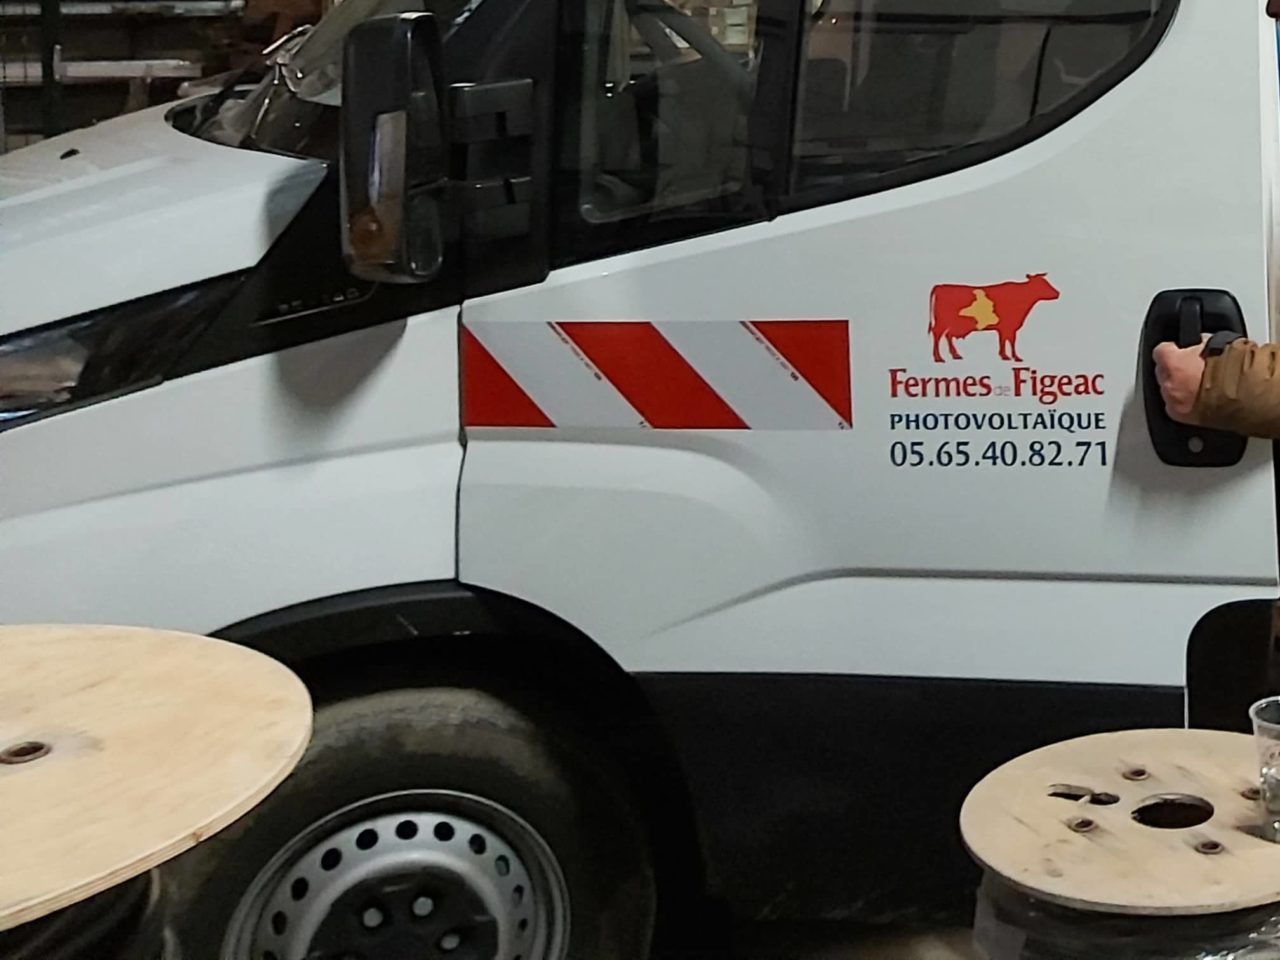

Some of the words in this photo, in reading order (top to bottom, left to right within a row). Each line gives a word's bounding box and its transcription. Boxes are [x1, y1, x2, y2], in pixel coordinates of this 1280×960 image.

[888, 368, 992, 398] Fermes
[993, 385, 1011, 397] de
[1012, 367, 1105, 405] Figeac
[889, 409, 1107, 433] PHOTOVOLTAÏQUE
[889, 440, 1108, 467] 05.65.40.82.71
